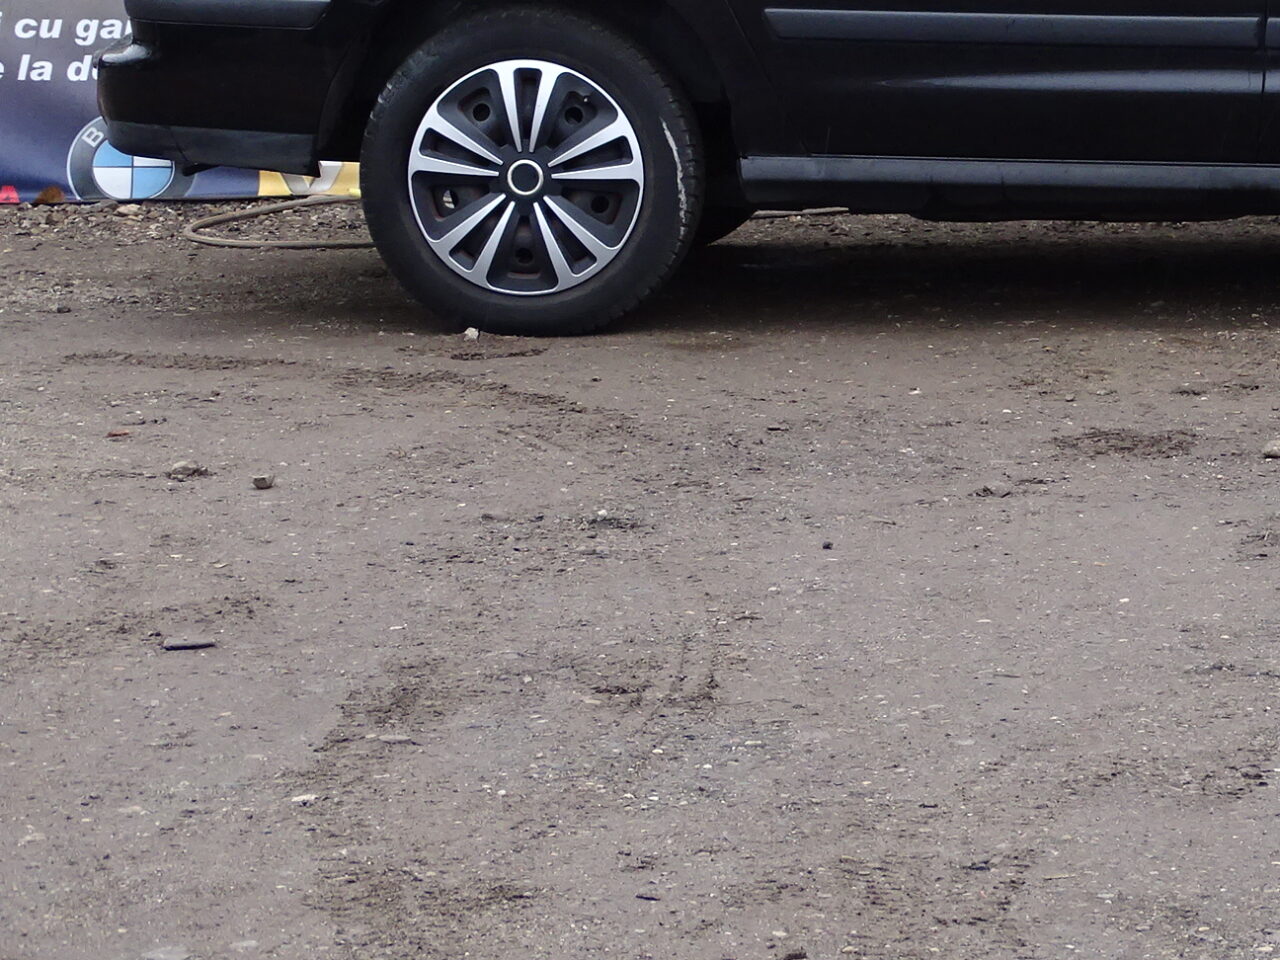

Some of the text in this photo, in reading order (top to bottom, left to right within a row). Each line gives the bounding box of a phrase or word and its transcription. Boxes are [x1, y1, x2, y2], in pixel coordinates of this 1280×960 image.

[15, 18, 62, 39] cu
[17, 54, 53, 81] la
[66, 55, 98, 82] d
